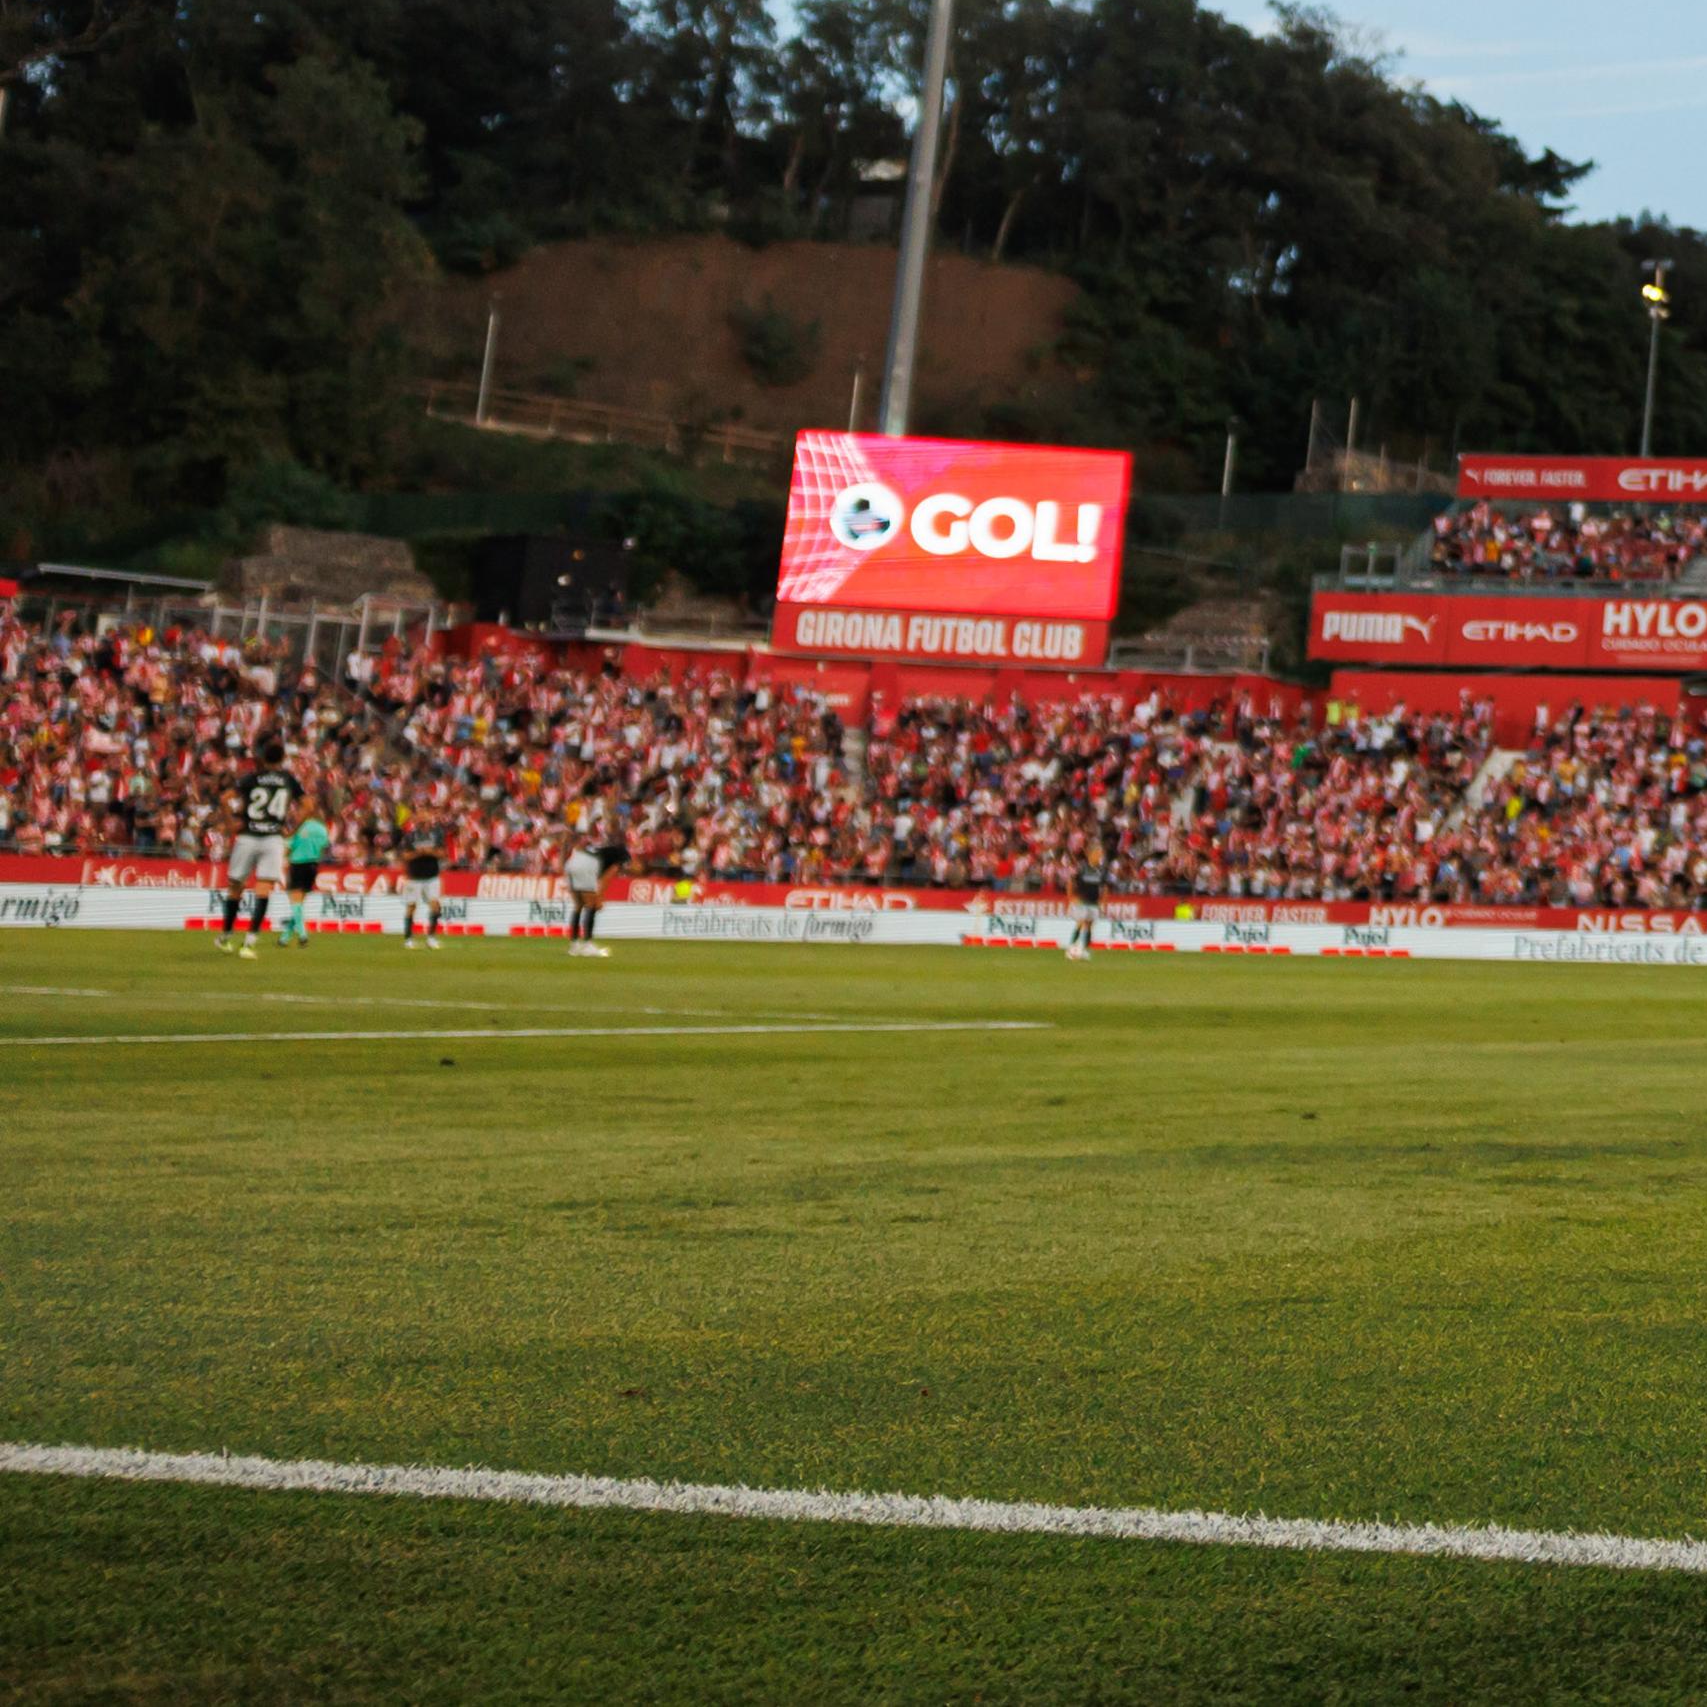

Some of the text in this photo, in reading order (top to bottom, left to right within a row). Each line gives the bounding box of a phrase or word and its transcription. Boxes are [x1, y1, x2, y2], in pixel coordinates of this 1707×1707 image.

[909, 493, 1103, 563] GOL!
[796, 610, 1084, 661] GIRONA FUTBOL CLUB
[1322, 611, 1405, 643] PUMA
[1461, 620, 1578, 643] ETIHAD
[247, 786, 288, 821] 24
[322, 895, 365, 922] Pujol
[437, 899, 467, 923] ujol
[528, 900, 566, 924] Pujol
[785, 889, 915, 911] ETIHAD
[988, 915, 1037, 937] Pujol
[1368, 905, 1445, 928] HYLO
[1111, 921, 1155, 941] Pujol
[1224, 922, 1270, 944] Pujol
[1343, 925, 1389, 947] Pujol
[1513, 934, 1665, 963] Prefabricats
[1674, 938, 1703, 964] de
